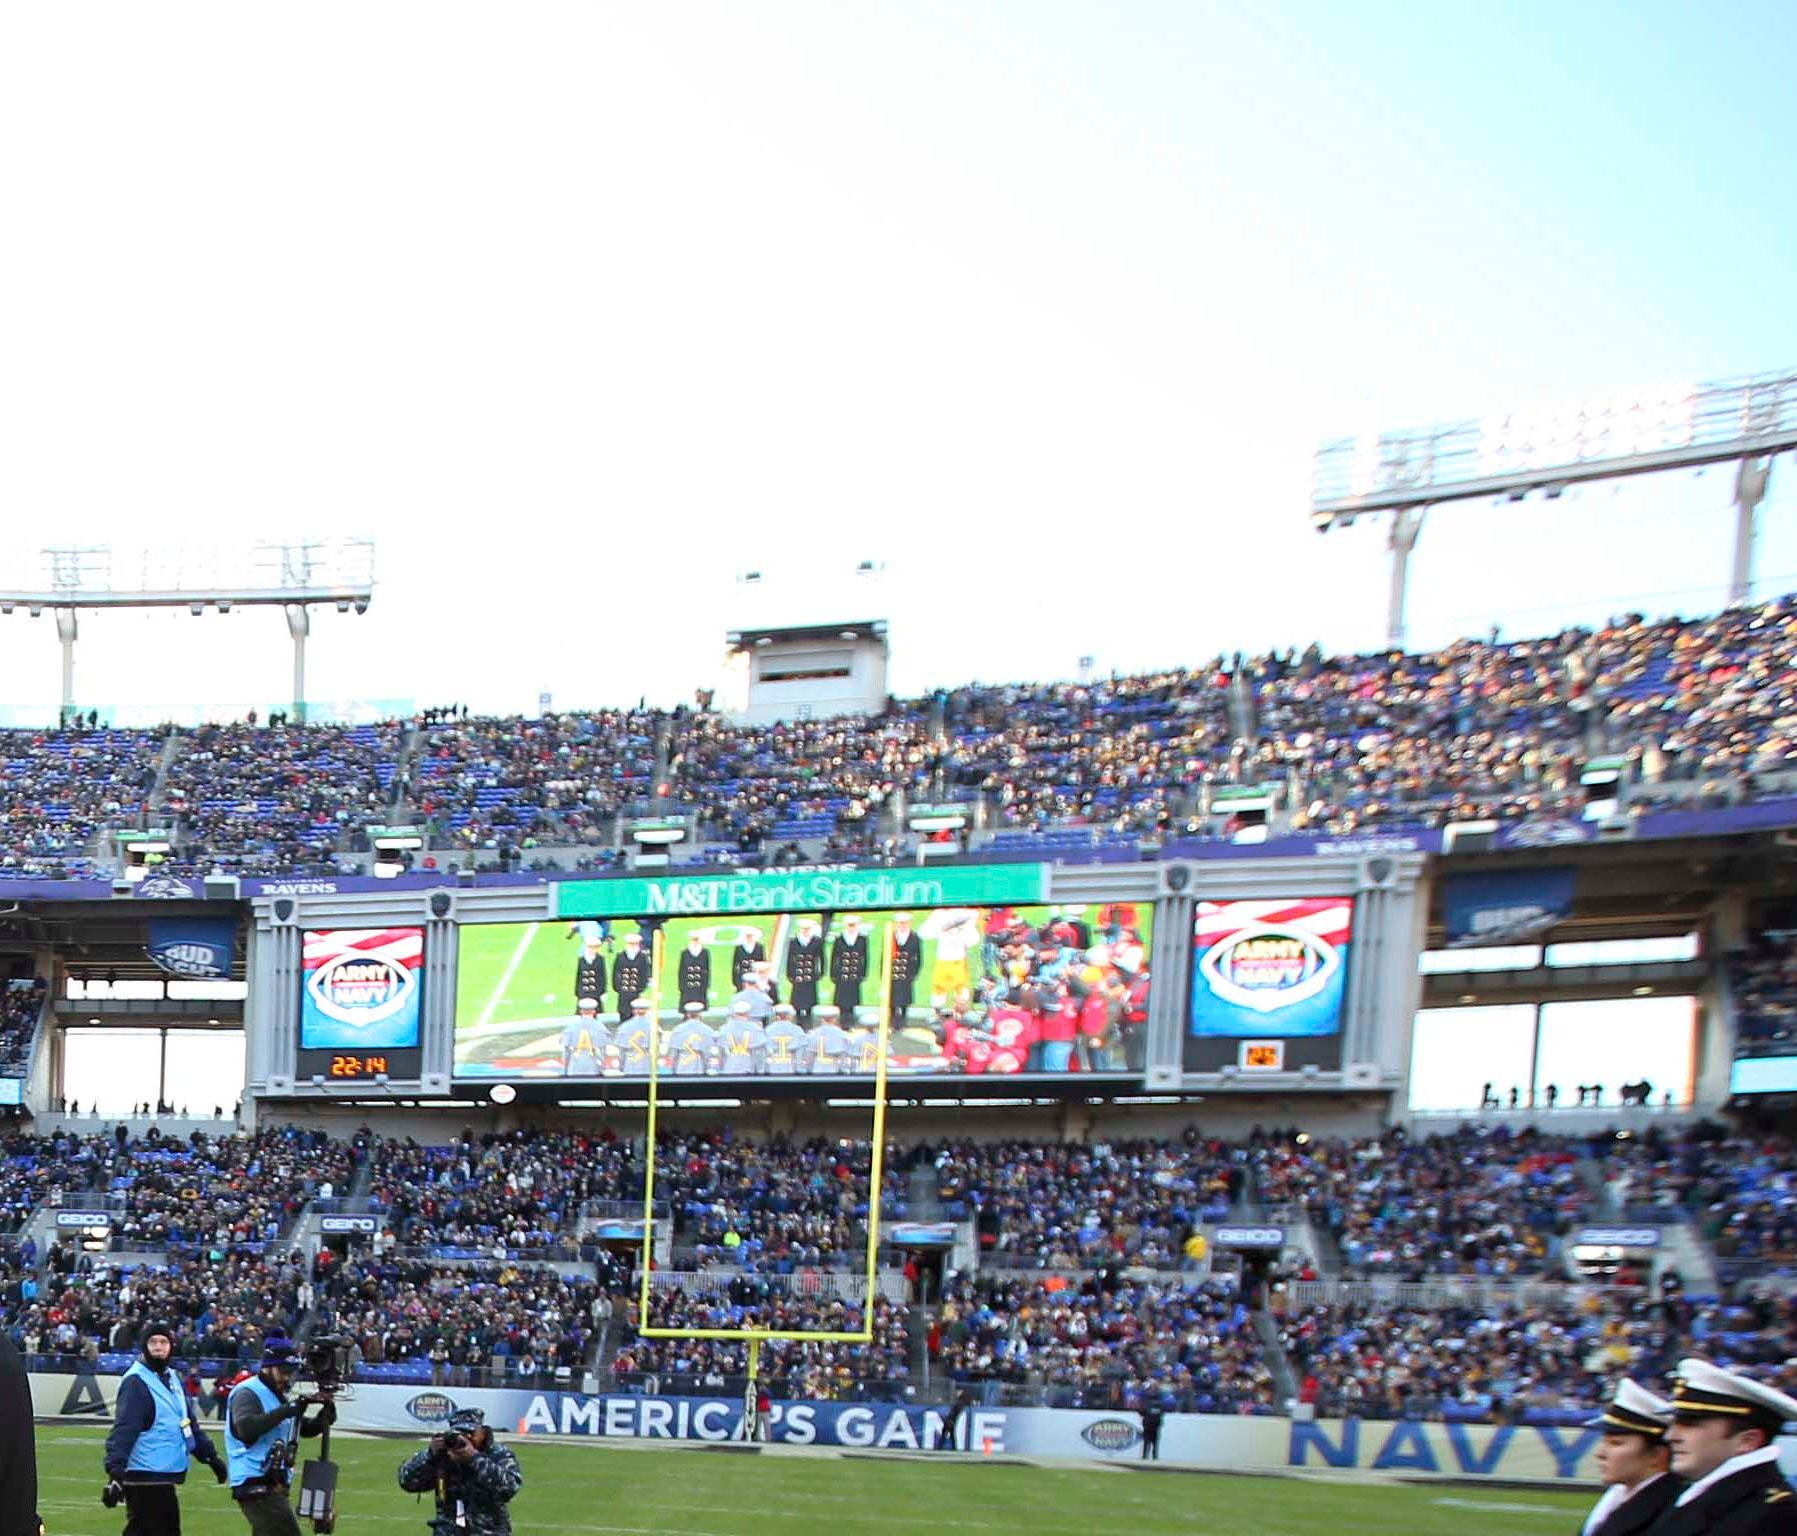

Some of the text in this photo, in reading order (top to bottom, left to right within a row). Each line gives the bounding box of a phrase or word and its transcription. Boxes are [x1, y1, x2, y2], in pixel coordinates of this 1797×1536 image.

[260, 882, 337, 894] RAVENS
[646, 876, 943, 913] M&T Bank Stadium
[1233, 938, 1305, 960] ARMY
[332, 965, 391, 982] ARMY
[333, 987, 389, 1003] NAVY
[57, 1213, 109, 1225] GEICO
[1218, 1228, 1282, 1243] GEICO
[1580, 1229, 1657, 1244] GEICO
[416, 1396, 449, 1406] ARMY
[417, 1409, 448, 1418] NAVY
[835, 1408, 1008, 1452] GAME
[1288, 1416, 1603, 1478] NAVY
